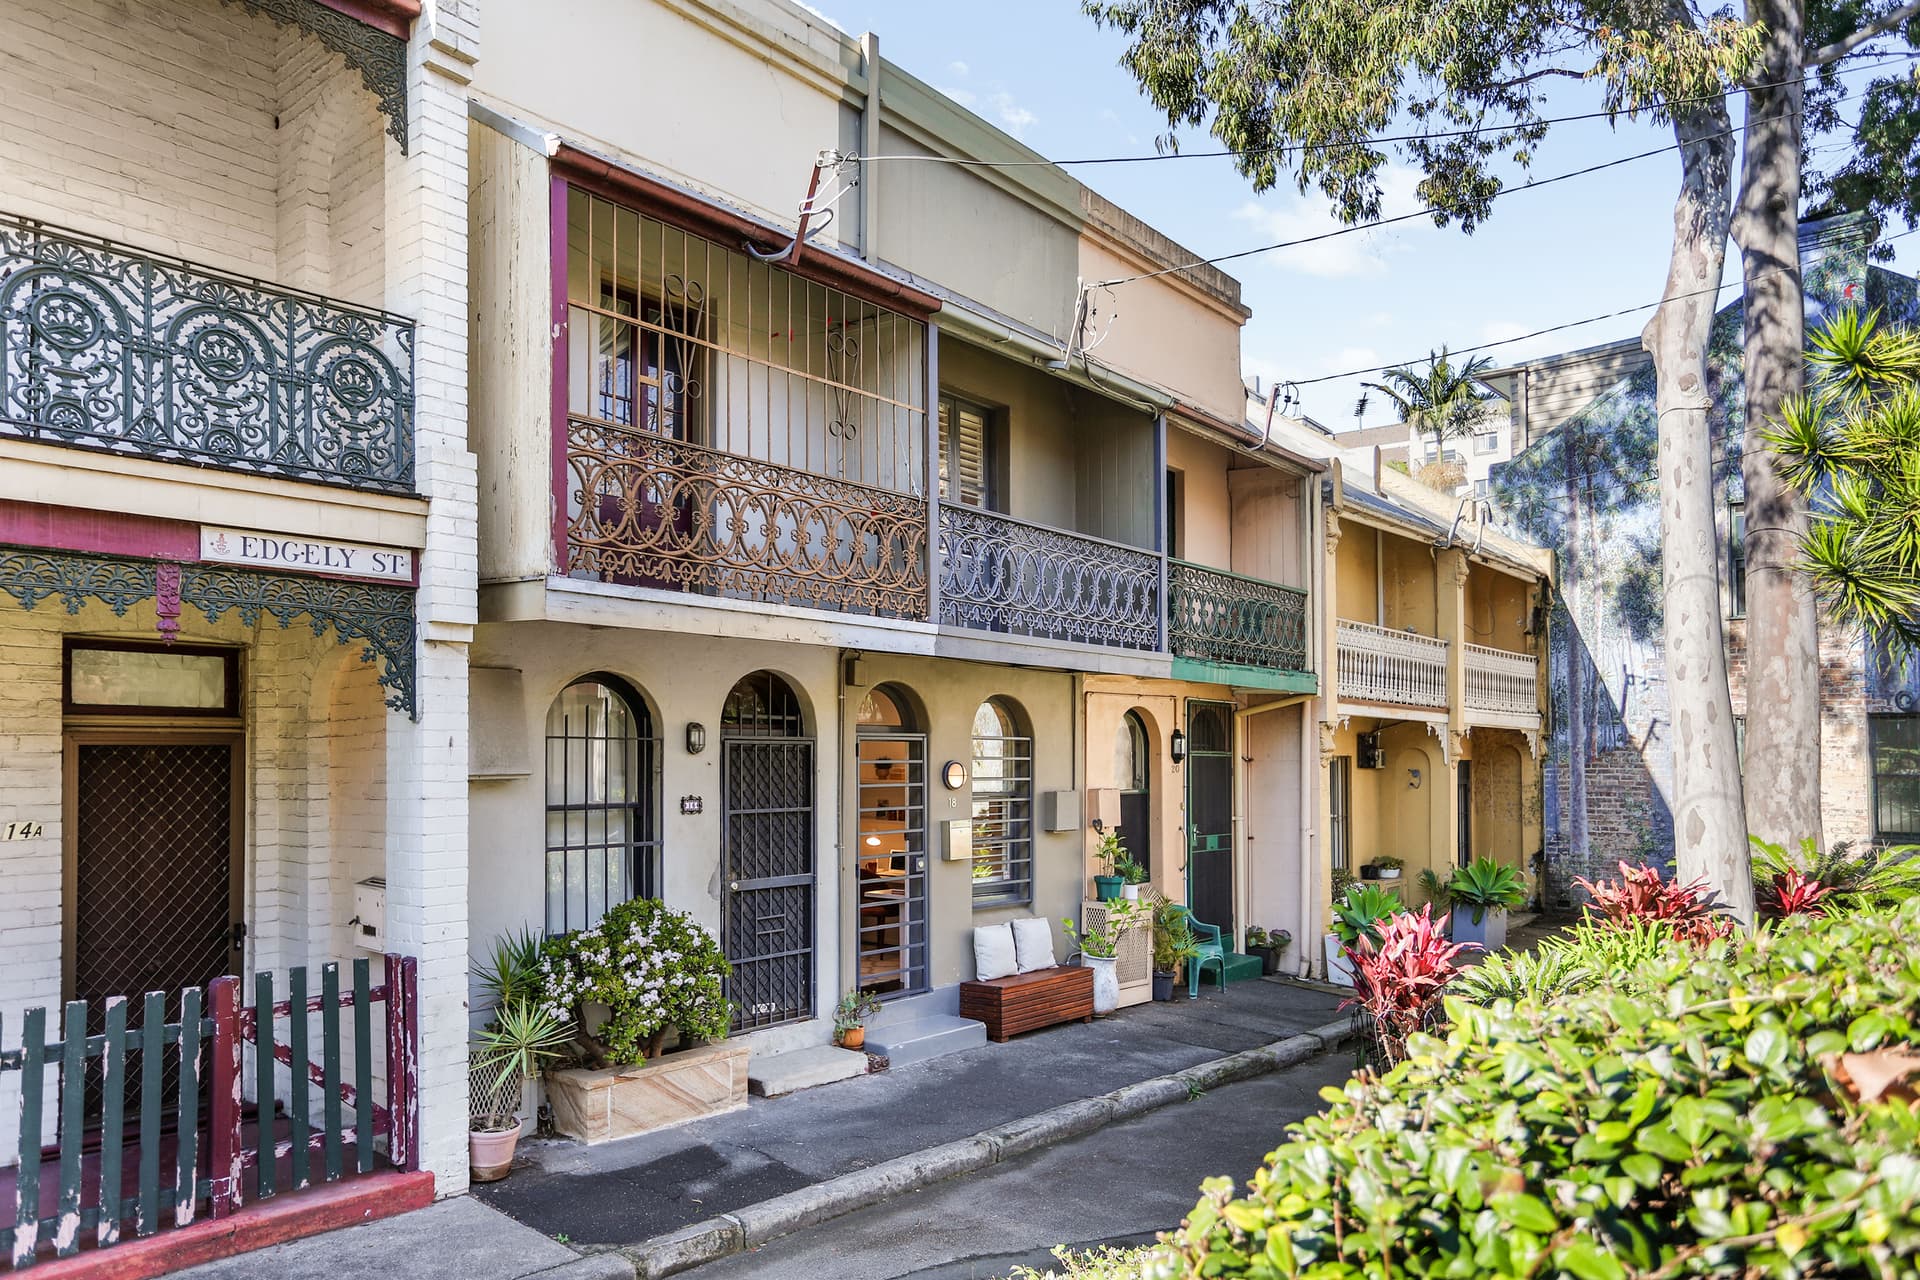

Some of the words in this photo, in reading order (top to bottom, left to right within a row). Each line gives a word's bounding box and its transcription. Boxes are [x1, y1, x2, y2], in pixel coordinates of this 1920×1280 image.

[241, 536, 356, 569] EDGELY
[947, 797, 957, 809] 18
[8, 822, 42, 840] 14A
